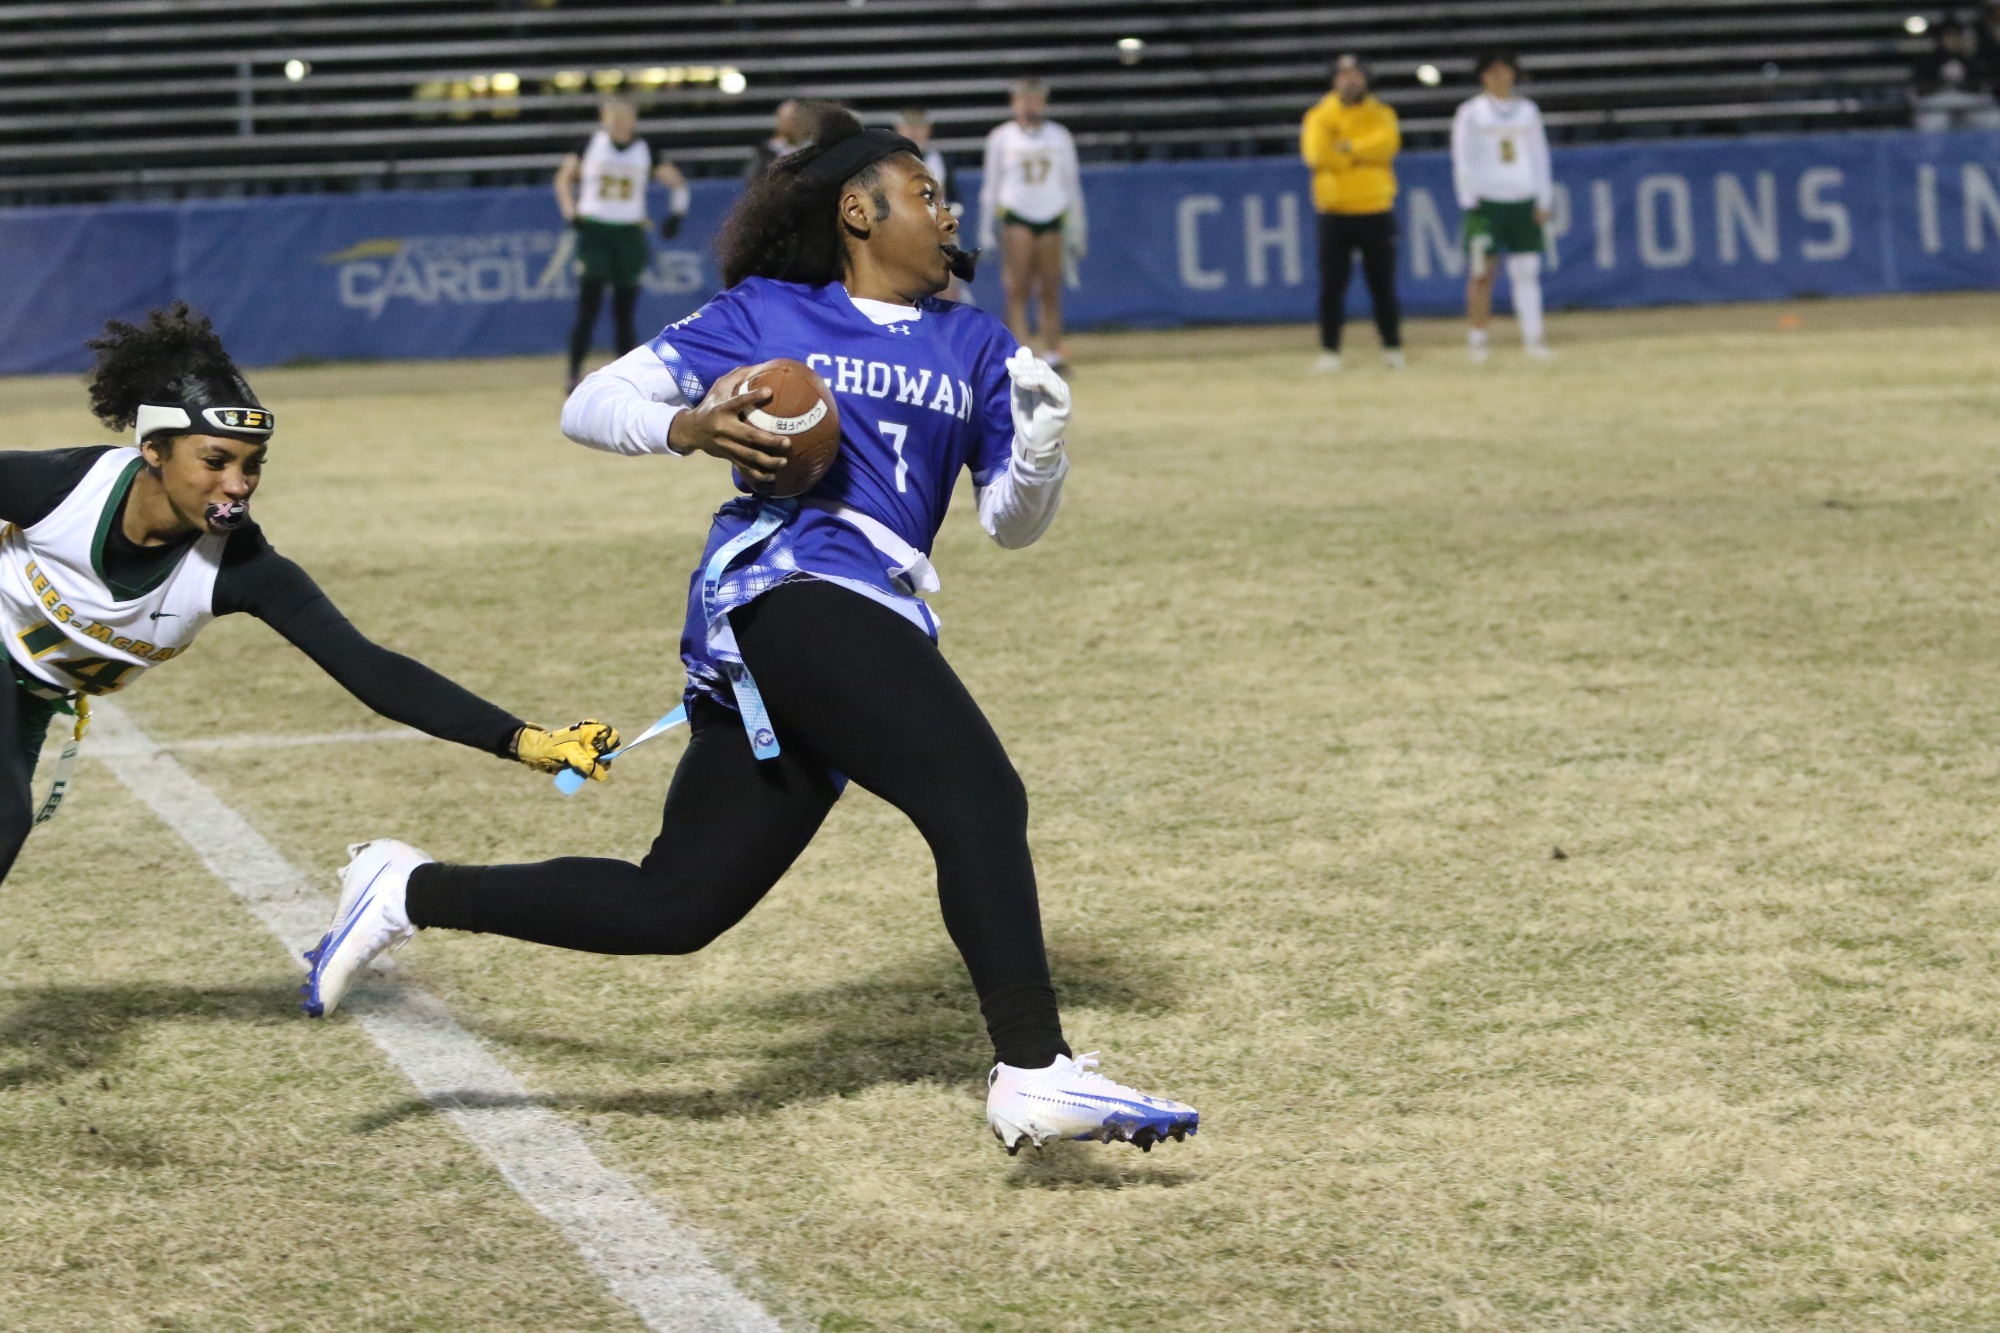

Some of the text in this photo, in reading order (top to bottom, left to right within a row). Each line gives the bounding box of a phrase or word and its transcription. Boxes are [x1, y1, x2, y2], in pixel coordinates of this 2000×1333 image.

[806, 353, 974, 424] CHOWAN
[878, 420, 908, 493] 7
[25, 560, 192, 662] LEES-McRA
